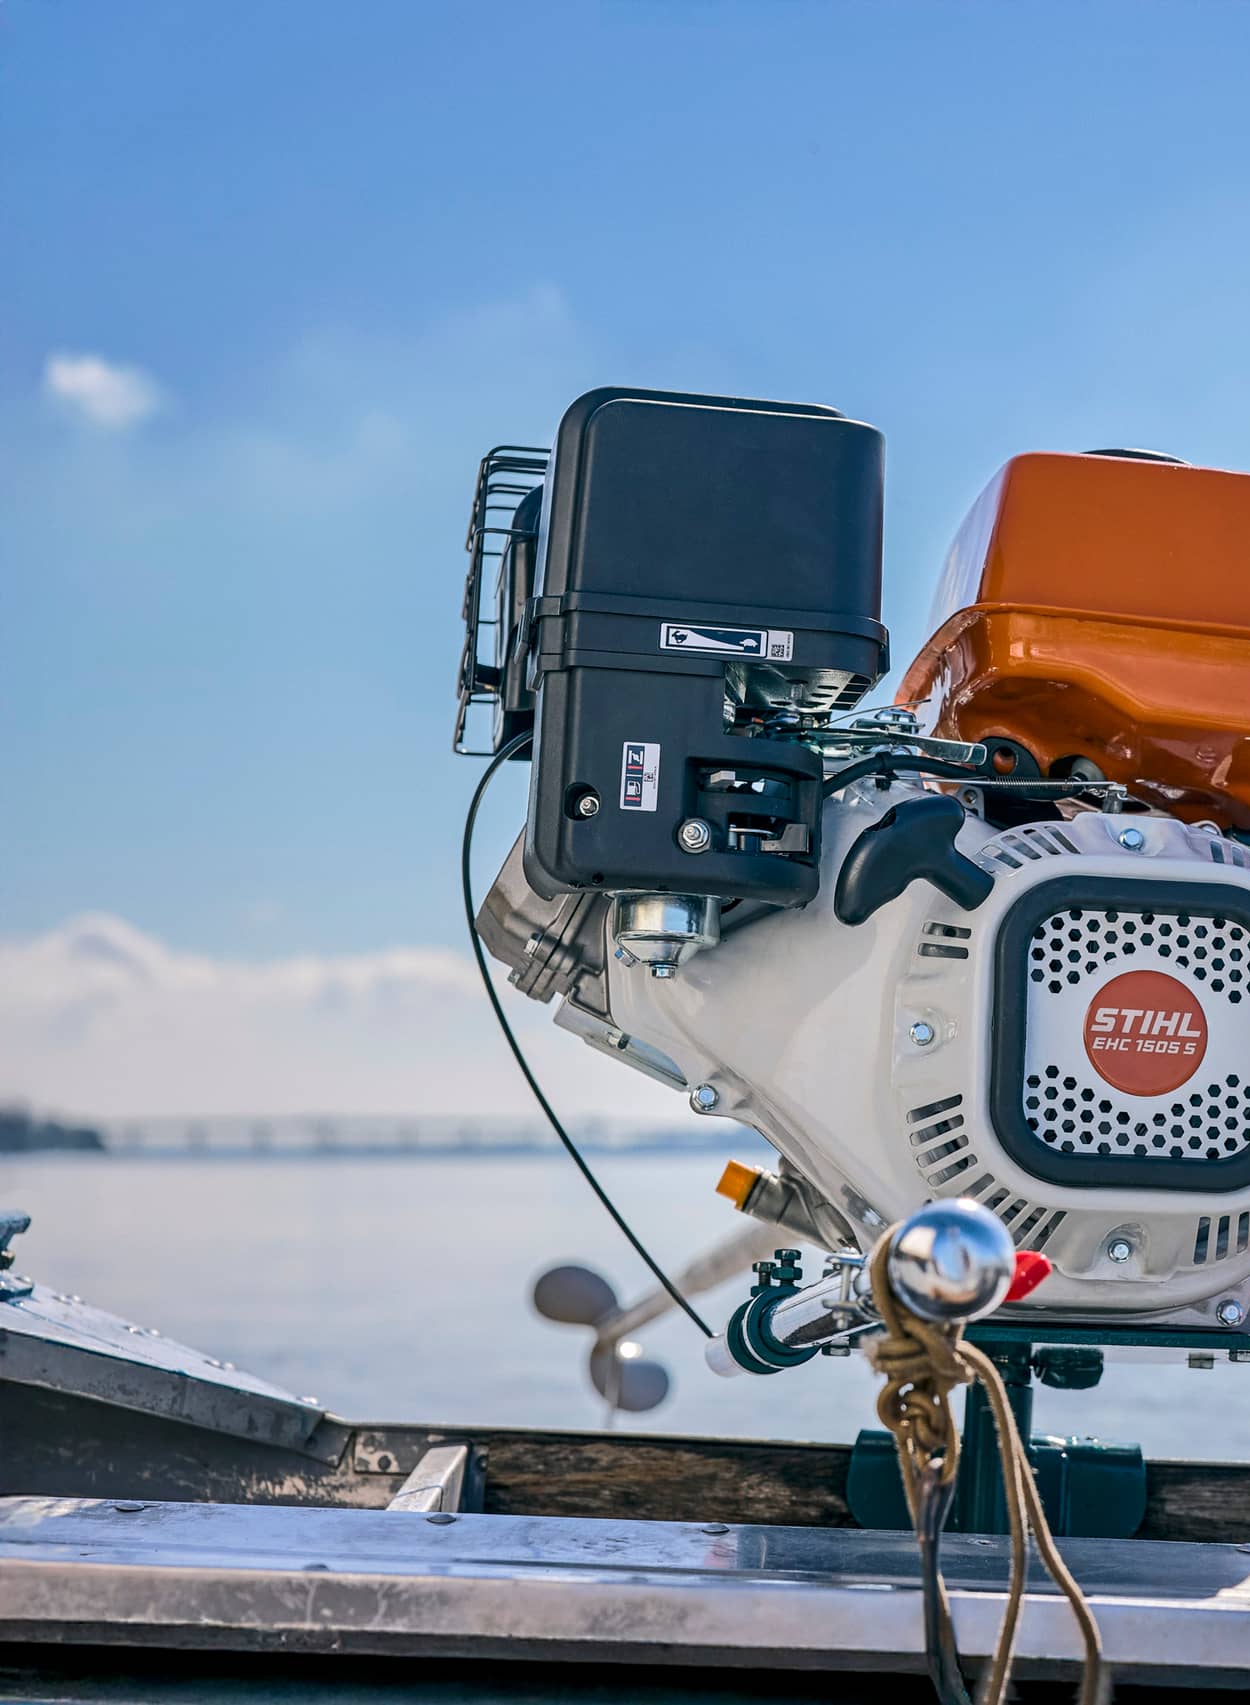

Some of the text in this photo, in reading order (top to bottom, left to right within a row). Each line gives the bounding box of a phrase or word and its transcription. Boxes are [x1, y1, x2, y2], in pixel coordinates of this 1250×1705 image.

[1091, 1007, 1201, 1038] STIHL
[1092, 1036, 1197, 1055] EHC 1505 S
